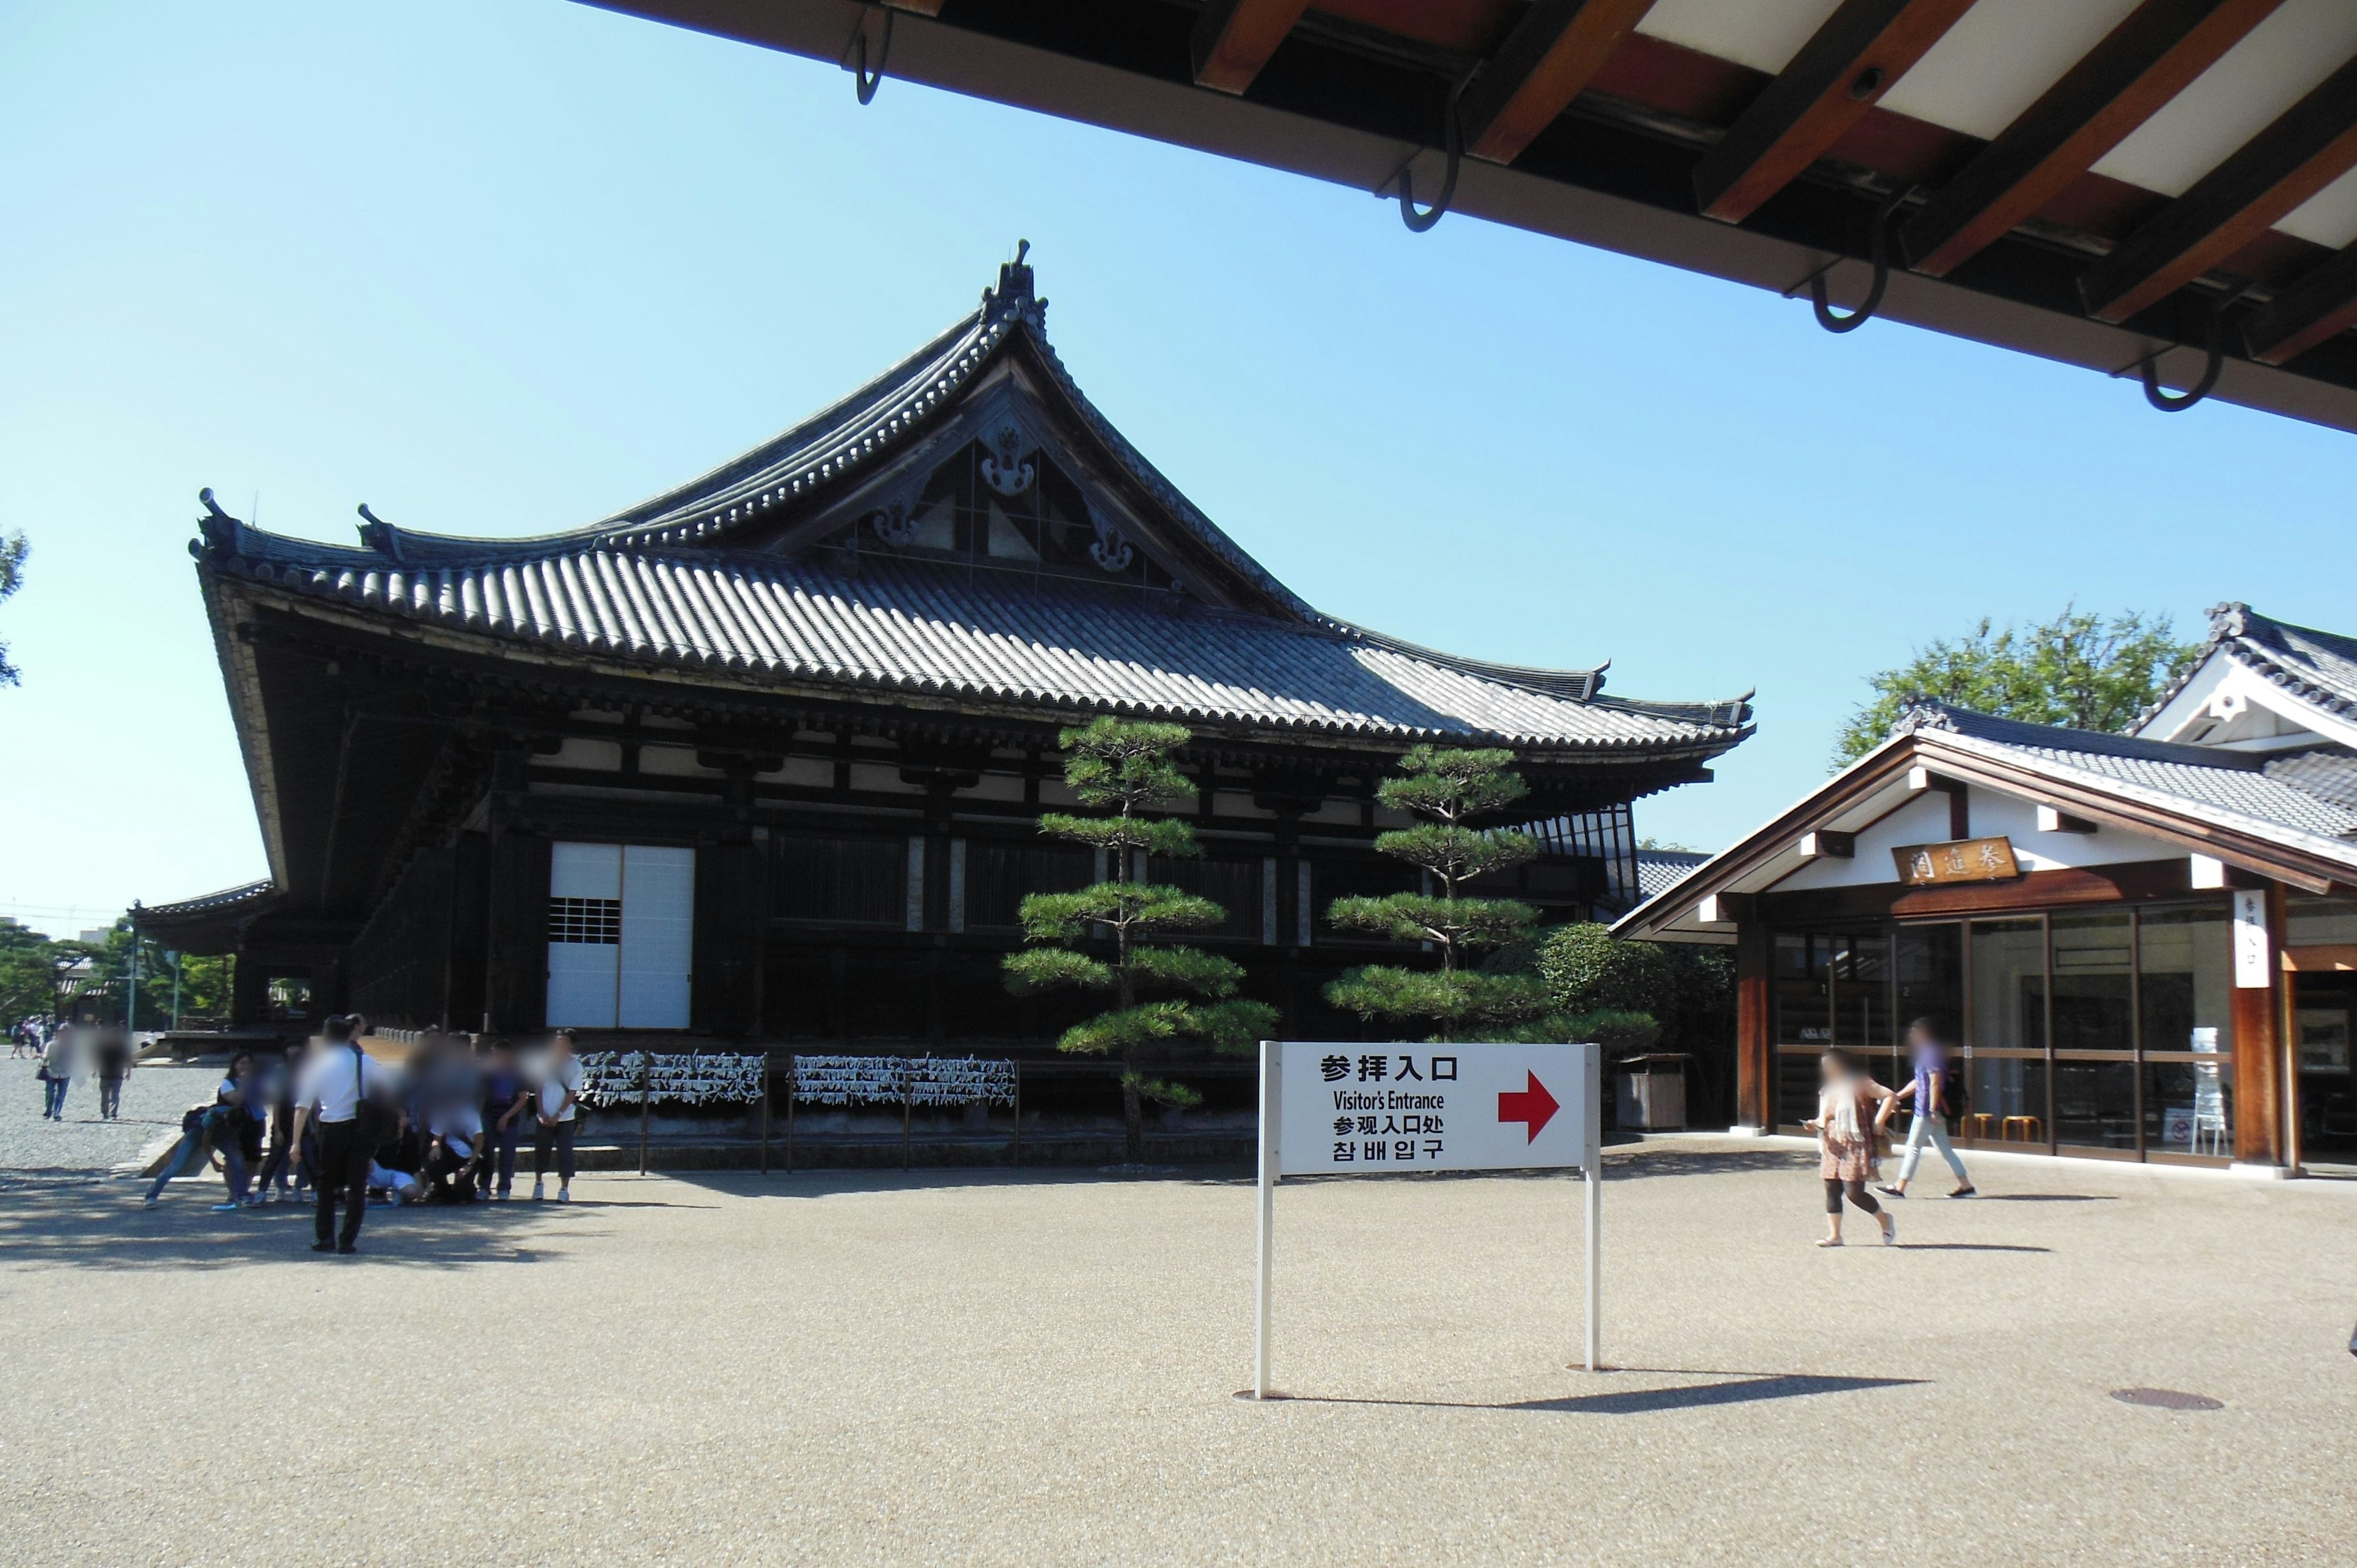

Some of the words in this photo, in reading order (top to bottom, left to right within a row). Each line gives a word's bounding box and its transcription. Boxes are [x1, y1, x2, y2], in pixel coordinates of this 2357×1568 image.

[1320, 1054, 1457, 1083] 参拝入口
[1333, 1090, 1385, 1110] Visitor's
[1388, 1090, 1444, 1110] Entrance
[1333, 1115, 1444, 1136] 参观入口处
